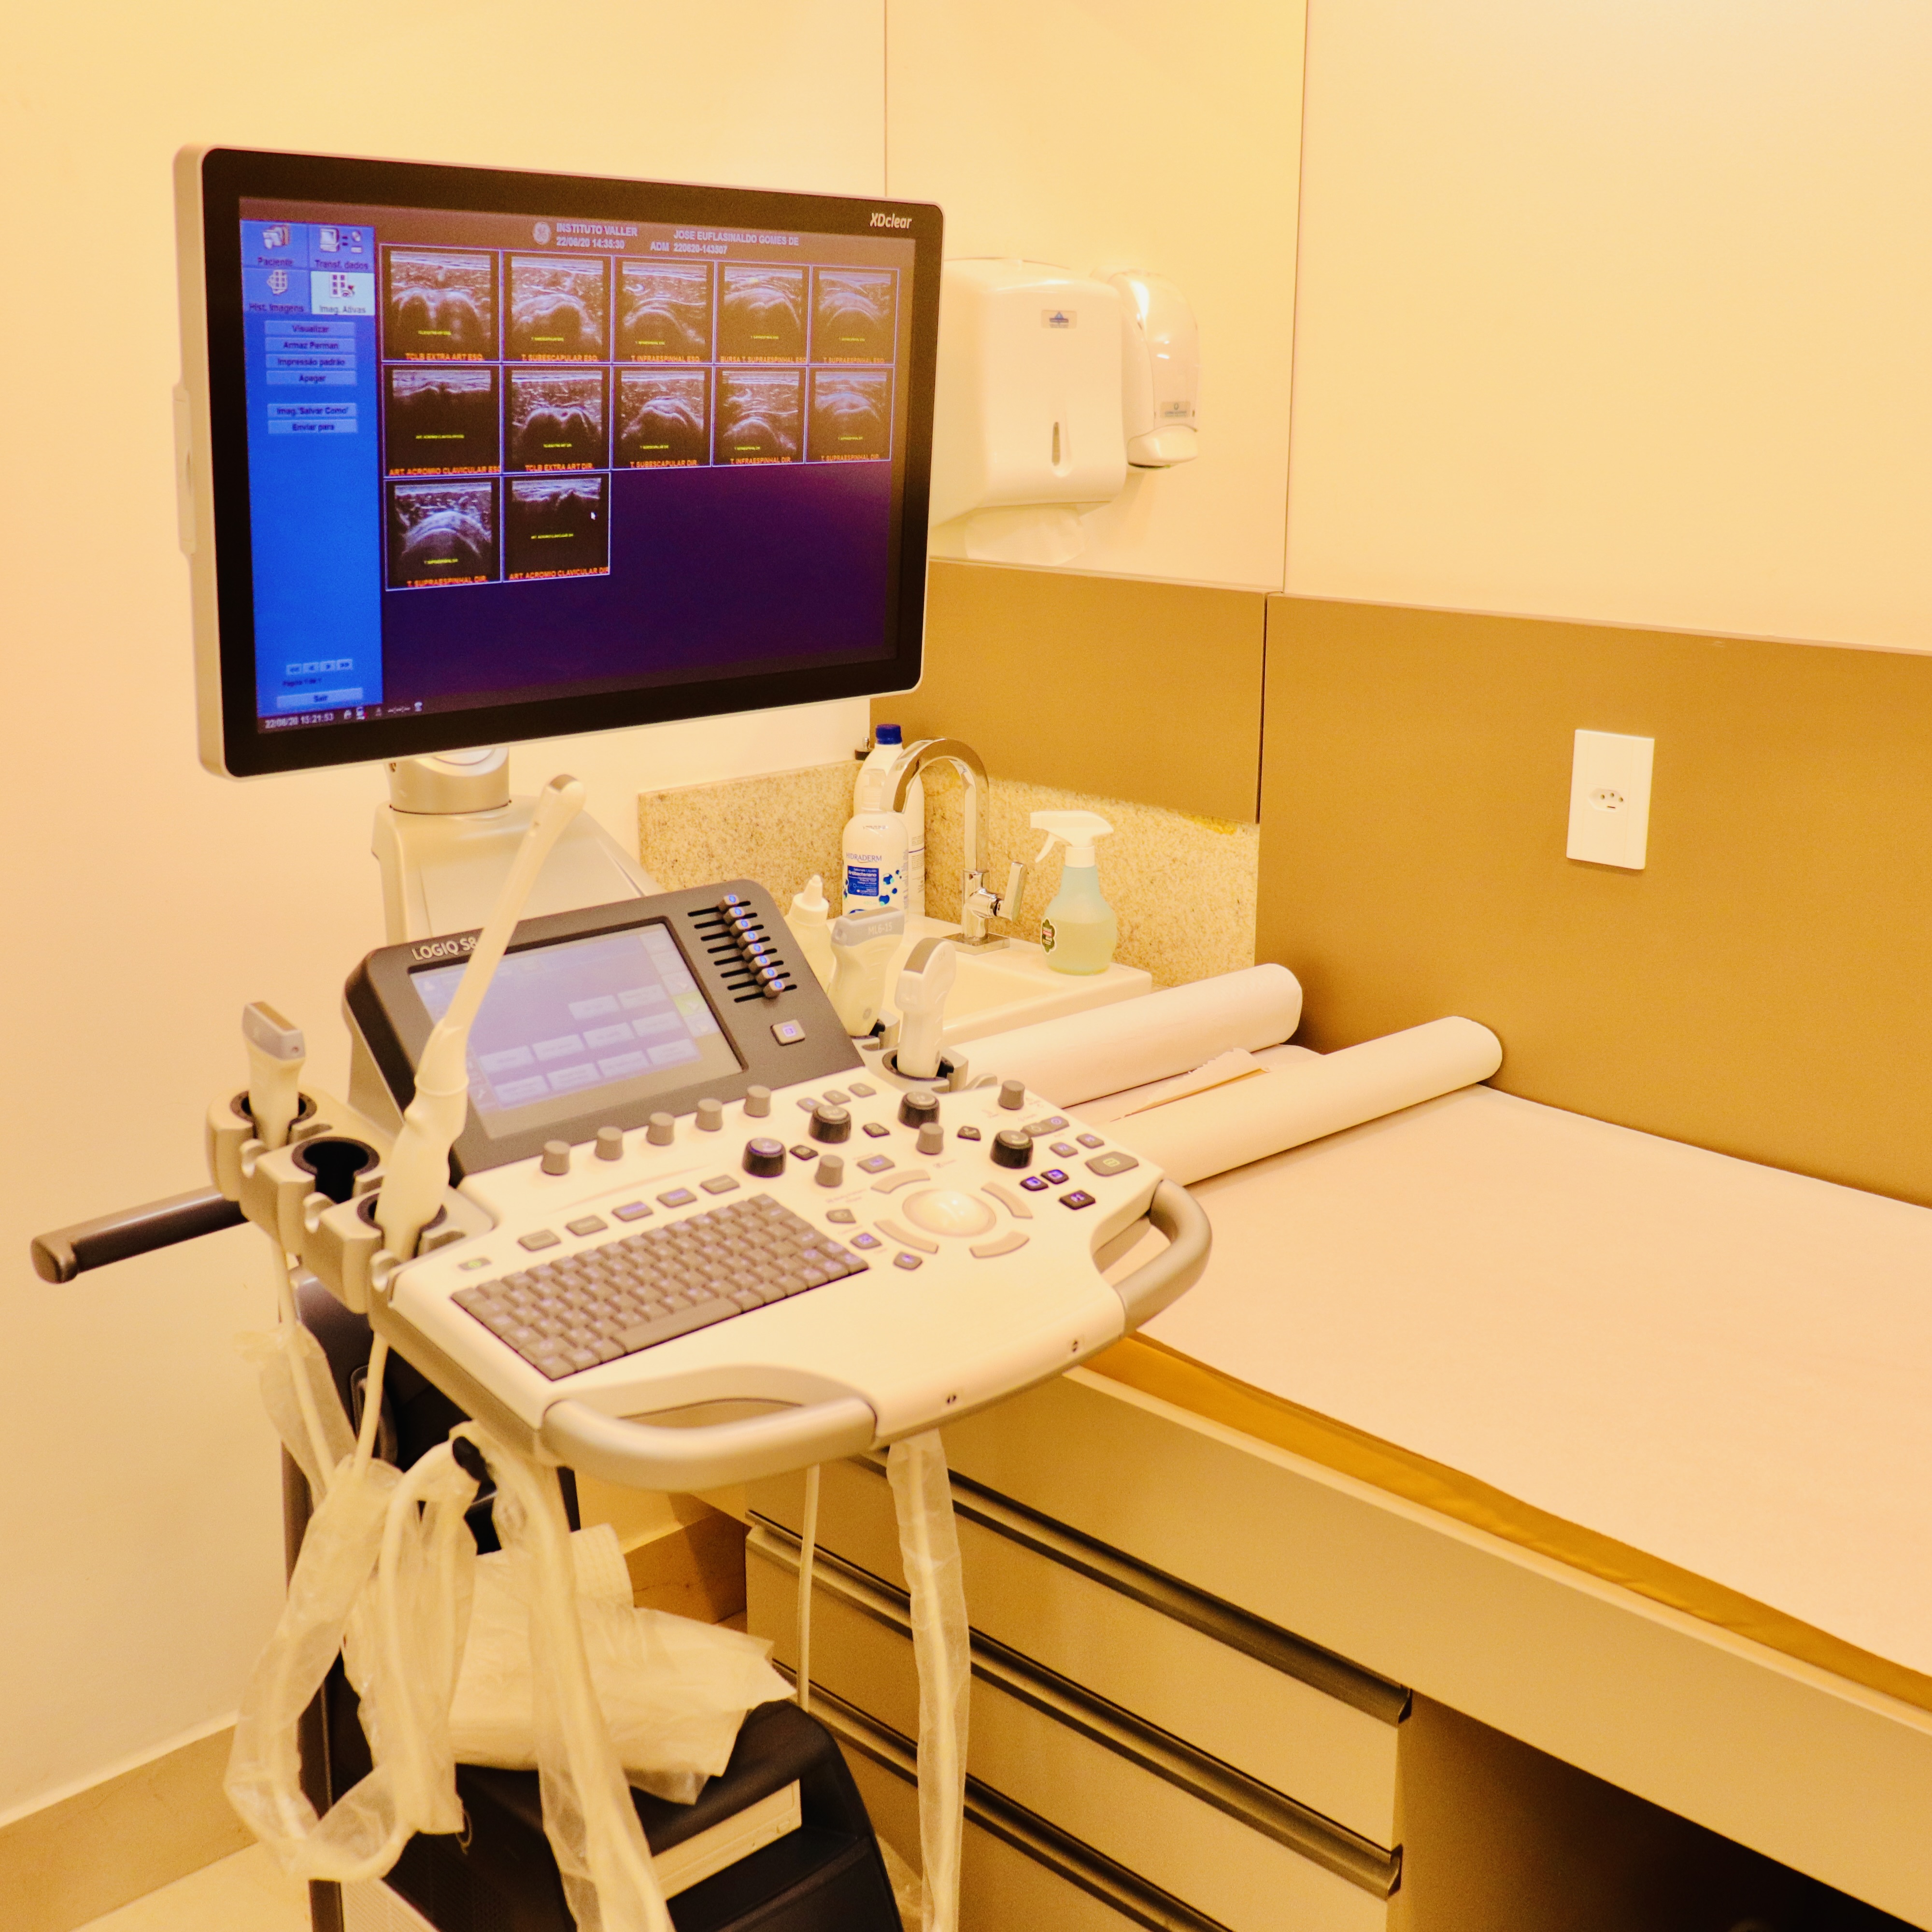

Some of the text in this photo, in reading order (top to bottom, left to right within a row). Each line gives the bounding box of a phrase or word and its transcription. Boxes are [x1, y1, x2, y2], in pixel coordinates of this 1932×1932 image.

[869, 213, 912, 229] XDclear
[556, 223, 602, 235] INSTITUTO
[604, 226, 638, 237] VALLER
[674, 230, 695, 240] JOSE
[759, 235, 785, 245] GOMES
[788, 236, 799, 246] DE
[651, 242, 669, 252] ADM
[257, 257, 294, 266] Paciente
[344, 261, 368, 270] dados
[846, 852, 882, 862] HIDRADERM
[411, 940, 459, 961] LOGIQ
